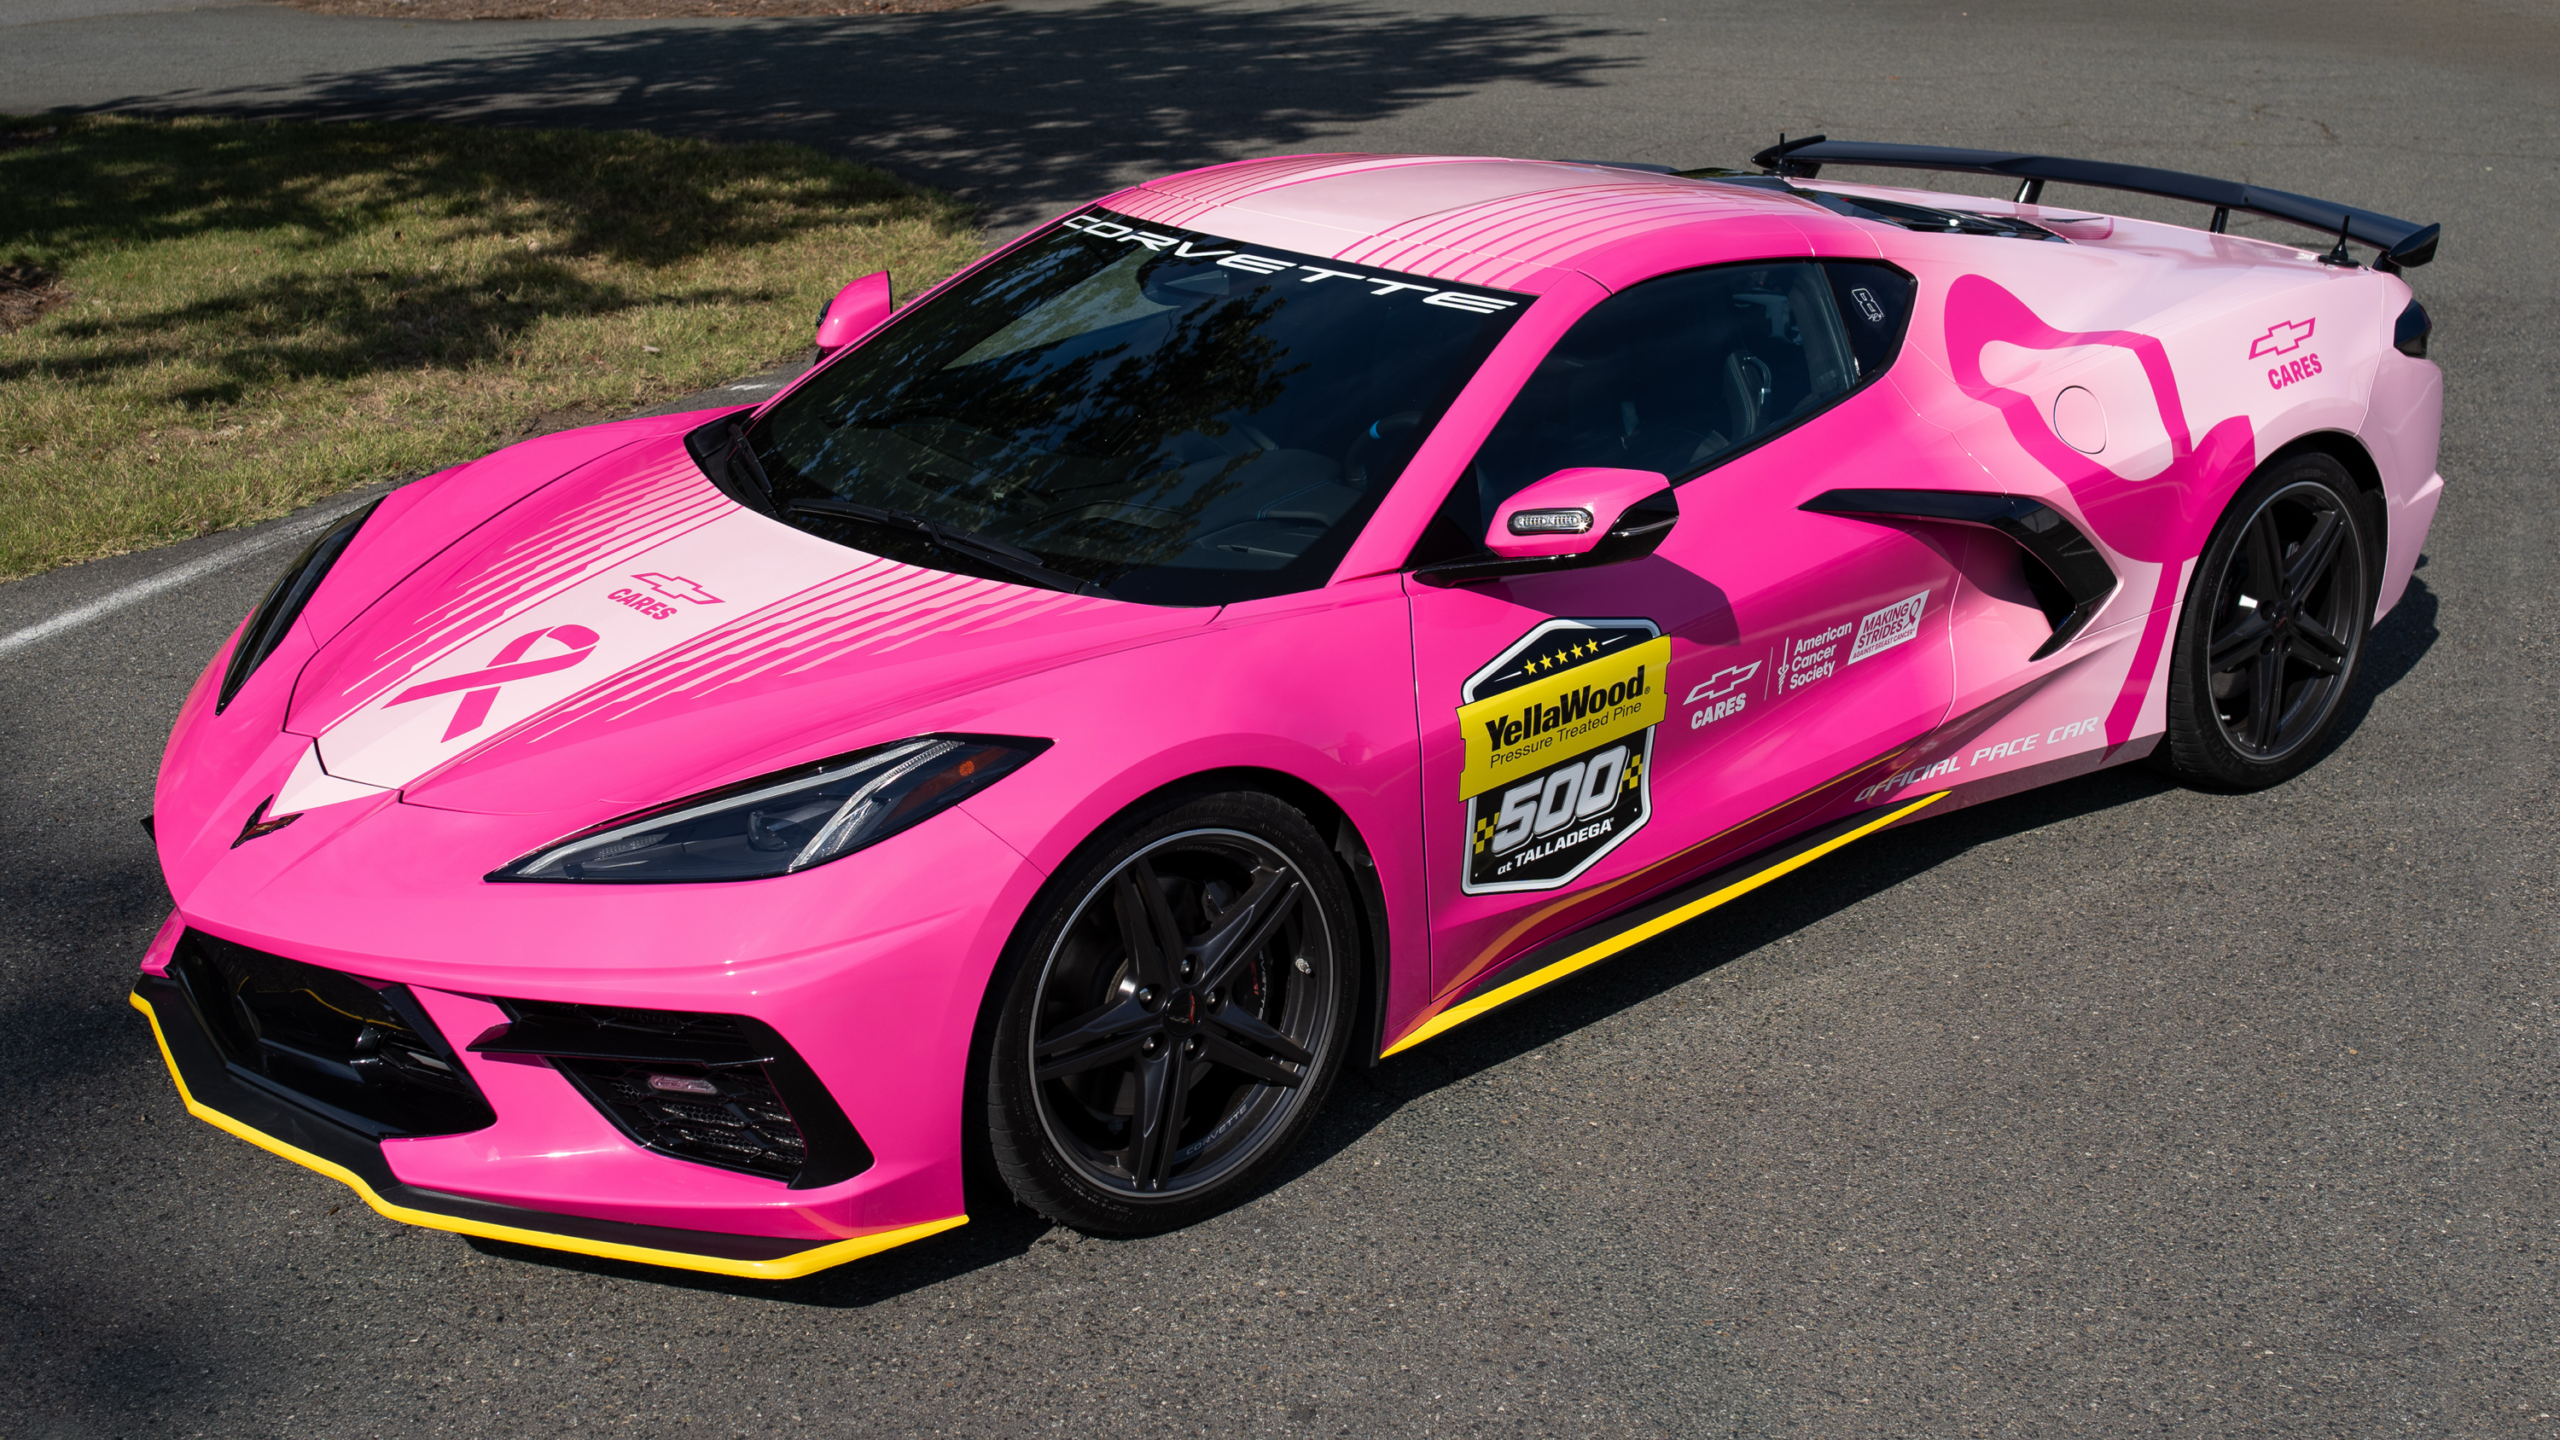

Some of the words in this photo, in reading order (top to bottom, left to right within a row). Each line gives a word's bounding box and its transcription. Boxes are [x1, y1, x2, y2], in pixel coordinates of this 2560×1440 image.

[1062, 214, 1518, 314] CORVETTE
[2267, 352, 2323, 390] CARES
[607, 588, 678, 620] CARES
[1862, 602, 1910, 634] MAKING
[1793, 621, 1853, 657] American
[1852, 645, 1875, 660] AGAINST
[1874, 636, 1894, 651] BREAST
[1857, 618, 1904, 650] STRIDES
[1789, 660, 1837, 690] Society
[1791, 643, 1838, 672] Cancer
[1691, 692, 1747, 730] CARES
[1490, 736, 1554, 769] Pressure
[1556, 711, 1610, 742] Treated
[1613, 702, 1642, 721] Pine
[1854, 756, 1961, 803] OFFICIAL
[1970, 733, 2040, 766] PACE
[2046, 716, 2099, 745] CAR
[1491, 745, 1630, 856] 500
[1497, 861, 1513, 875] at
[1515, 818, 1613, 868] TALLADEGA
[1186, 1103, 1247, 1156] CORVETTE
